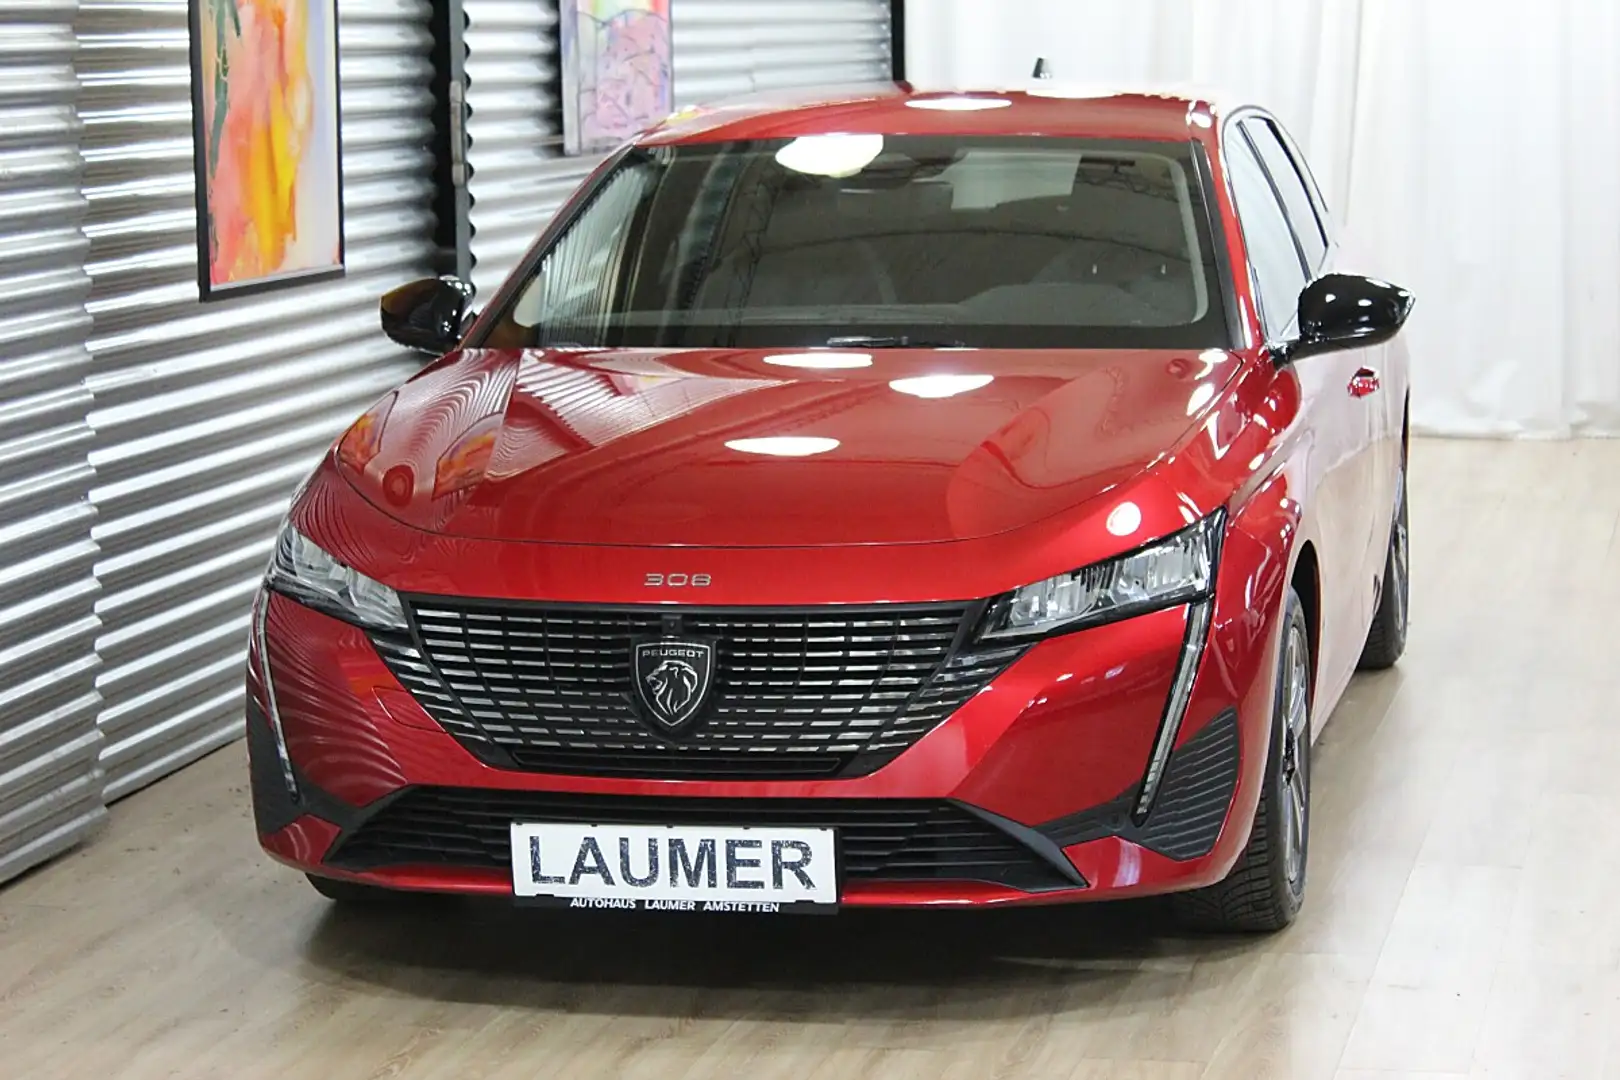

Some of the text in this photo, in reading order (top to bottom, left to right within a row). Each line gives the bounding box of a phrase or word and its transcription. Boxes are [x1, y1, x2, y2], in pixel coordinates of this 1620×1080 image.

[644, 573, 711, 587] 308
[642, 649, 704, 658] PEUGEOT
[529, 835, 817, 890] LAUMER
[570, 897, 780, 913] AUTOHAUS LAUMER AMSTETTEN
